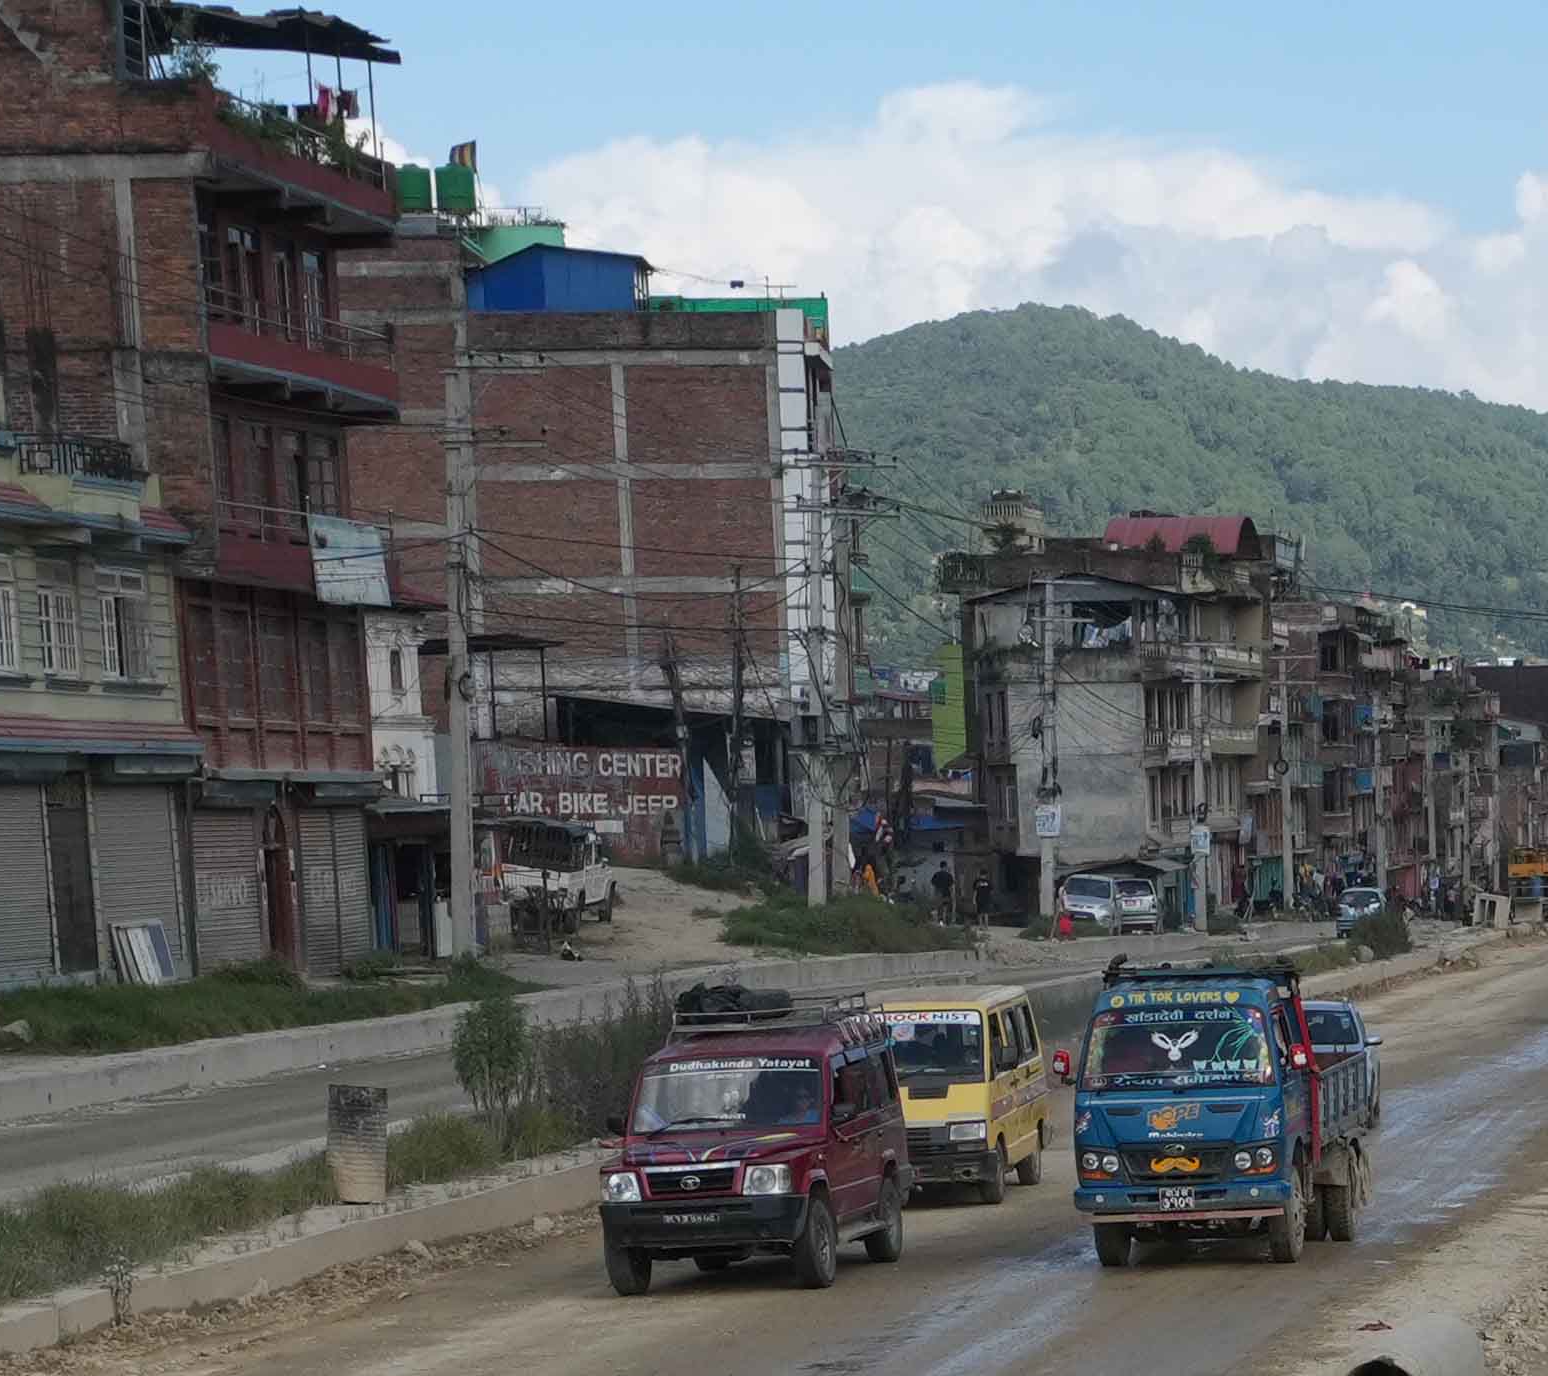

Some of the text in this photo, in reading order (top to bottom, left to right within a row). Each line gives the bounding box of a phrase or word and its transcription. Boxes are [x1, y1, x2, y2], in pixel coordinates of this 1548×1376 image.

[598, 753, 682, 778] CENTER
[618, 795, 678, 815] JEEP
[1129, 991, 1222, 1004] TIK TOK LOVERS
[669, 1058, 812, 1073] Dudhakunda Yatayat
